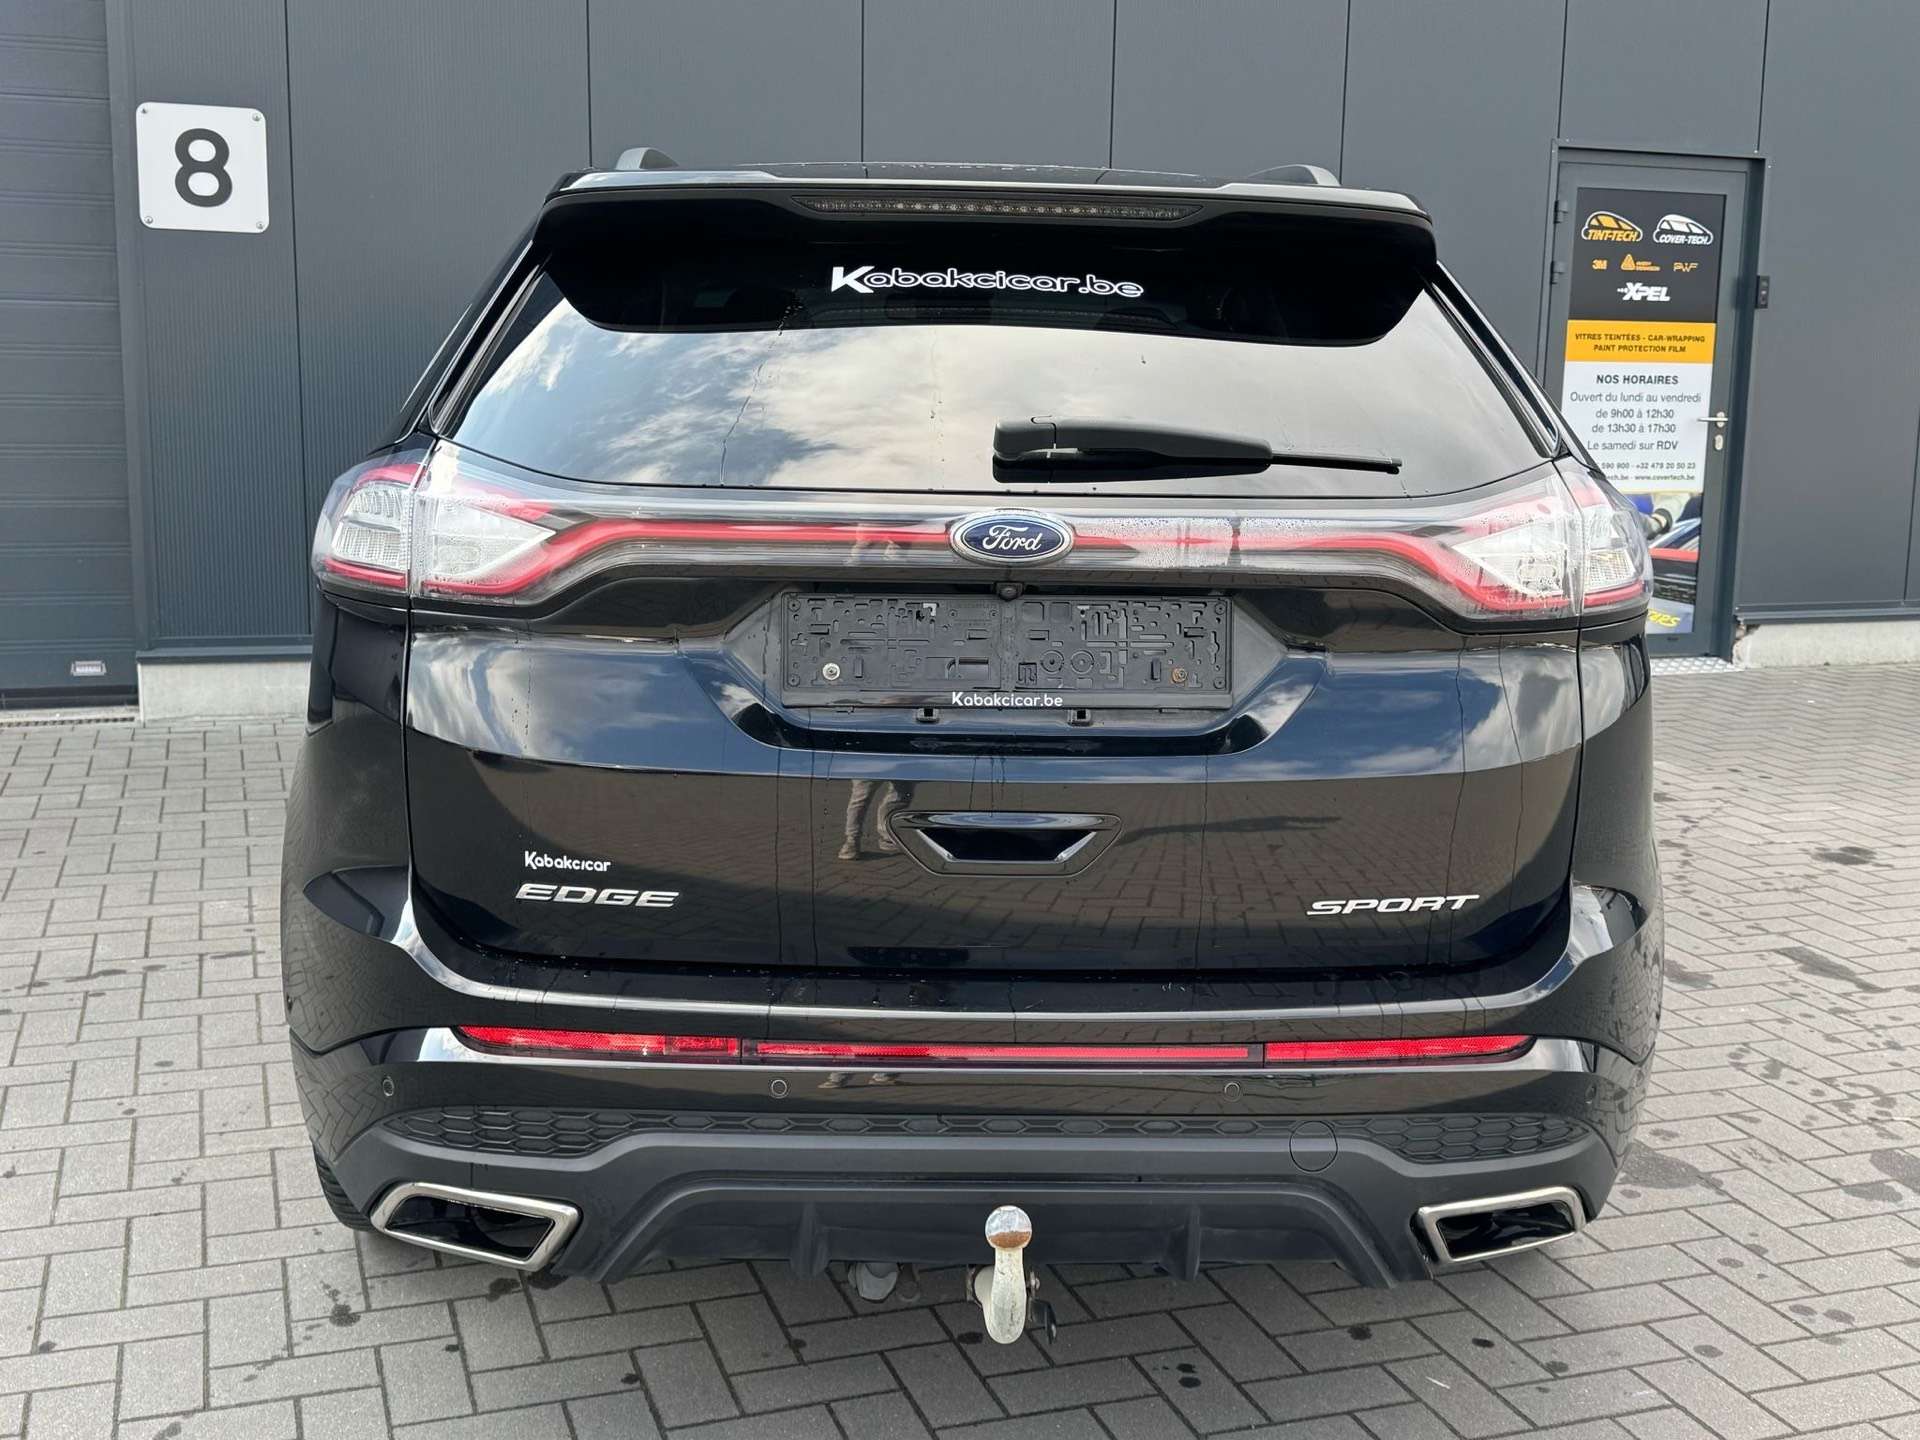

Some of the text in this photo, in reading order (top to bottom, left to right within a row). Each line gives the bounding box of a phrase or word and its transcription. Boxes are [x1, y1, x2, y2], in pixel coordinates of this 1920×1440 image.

[174, 128, 233, 208] 8
[1587, 229, 1638, 242] TINT-TECH
[1658, 234, 1708, 245] COVER-TECH
[1592, 259, 1608, 270] 3M
[831, 265, 1144, 298] Kabakcicar.be
[1621, 282, 1671, 302] XPEL
[1575, 333, 1602, 341] VITRES
[1648, 334, 1705, 343] CAR-WRAPPING
[1593, 344, 1616, 352] PAINT
[1596, 374, 1679, 385] NOS HORAIRES
[1570, 391, 1702, 403] Ouvert du lundi au vendredi
[1595, 409, 1608, 418] de
[1610, 409, 1634, 418] 9h00
[1646, 409, 1674, 419] 12h30
[1592, 424, 1604, 433] de
[1607, 423, 1636, 433] 13h30
[1648, 424, 1676, 433] 17h30
[1587, 440, 1679, 451] Le samedi sur RDV
[981, 525, 1044, 551] Ford
[951, 691, 1064, 706] Kabakcicar.be
[515, 882, 680, 908] EDGE
[1306, 894, 1481, 916] SPORT
